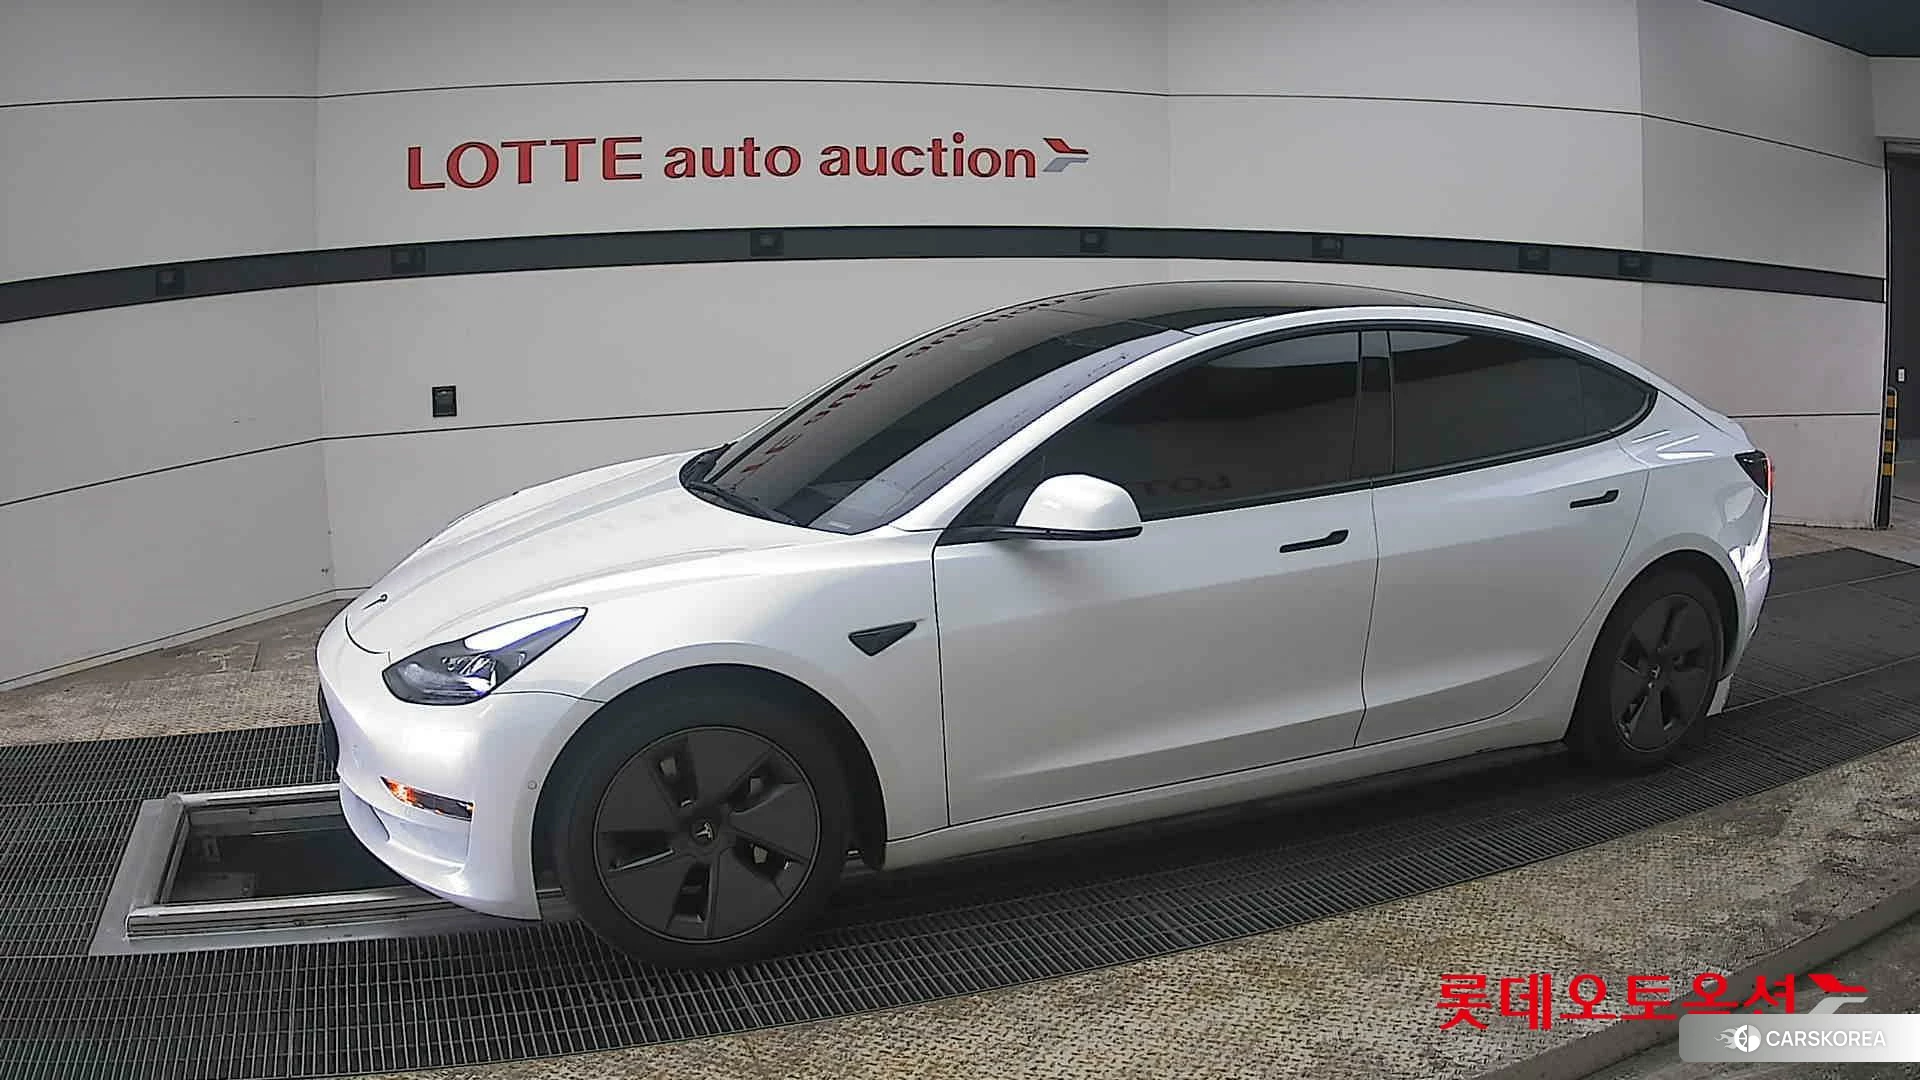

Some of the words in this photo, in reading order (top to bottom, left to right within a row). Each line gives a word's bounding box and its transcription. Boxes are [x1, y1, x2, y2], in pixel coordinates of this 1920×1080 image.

[406, 136, 643, 190] LOTTE
[662, 136, 801, 178] auto
[818, 132, 1037, 178] auction
